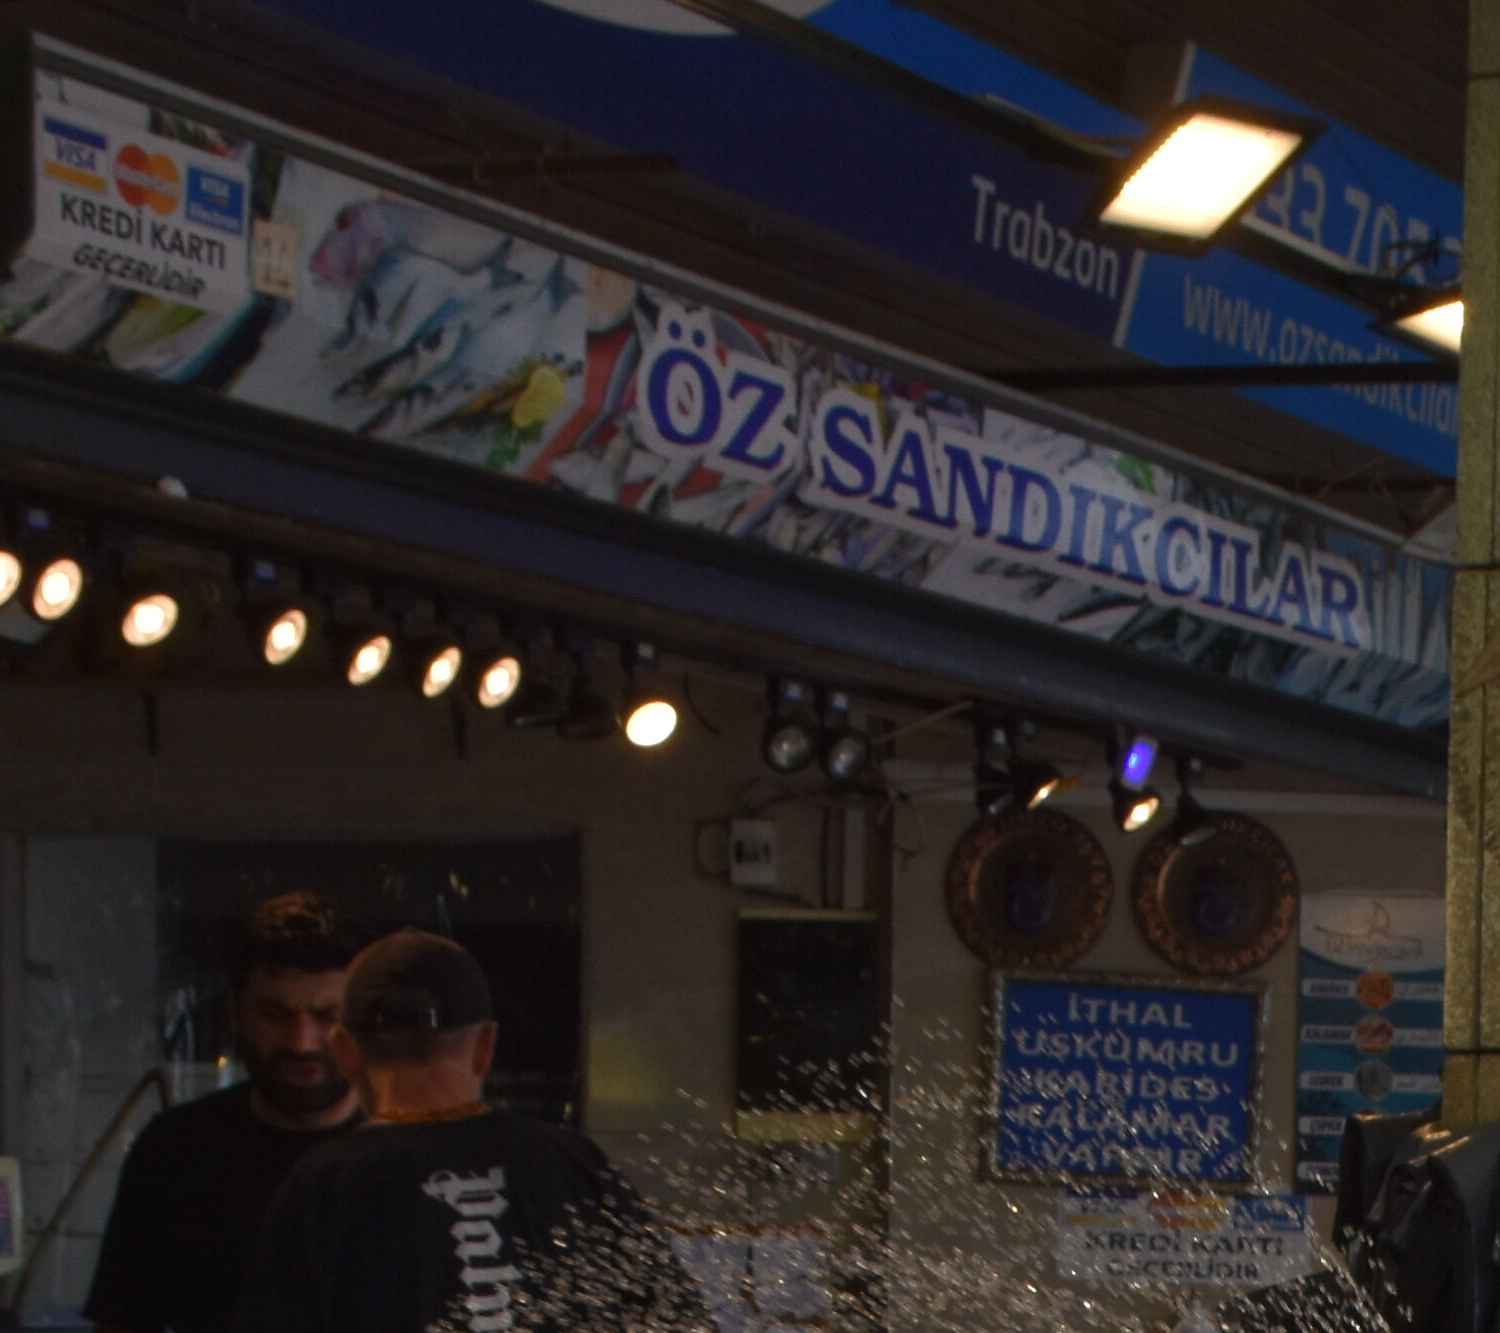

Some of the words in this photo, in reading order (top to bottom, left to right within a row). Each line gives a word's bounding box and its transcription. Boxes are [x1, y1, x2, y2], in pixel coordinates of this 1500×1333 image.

[60, 194, 143, 245] KREDİ
[150, 220, 227, 270] KARTI
[970, 174, 1120, 299] Trabzon
[647, 318, 787, 472] ÖZ
[821, 401, 1360, 648] SANDIKCILAR
[1068, 992, 1193, 1028] İTHAL
